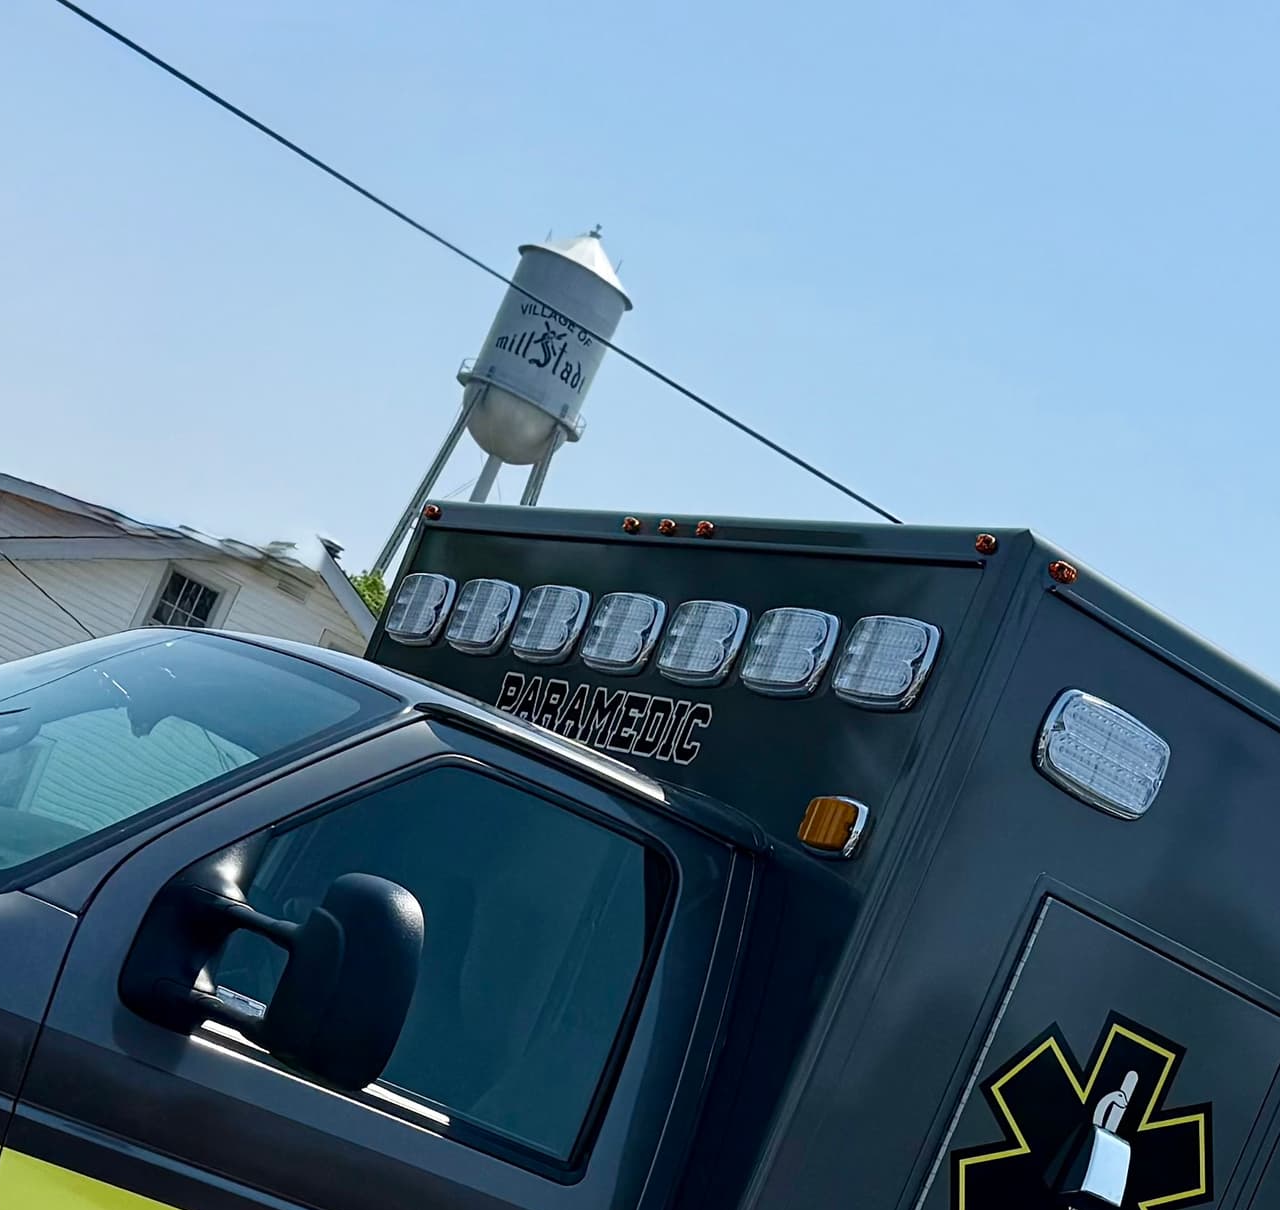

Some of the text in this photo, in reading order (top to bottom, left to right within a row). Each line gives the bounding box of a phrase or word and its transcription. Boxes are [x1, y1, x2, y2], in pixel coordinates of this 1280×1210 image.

[520, 303, 593, 348] VILLAGE OF
[495, 671, 713, 766] PARAMEDIC
